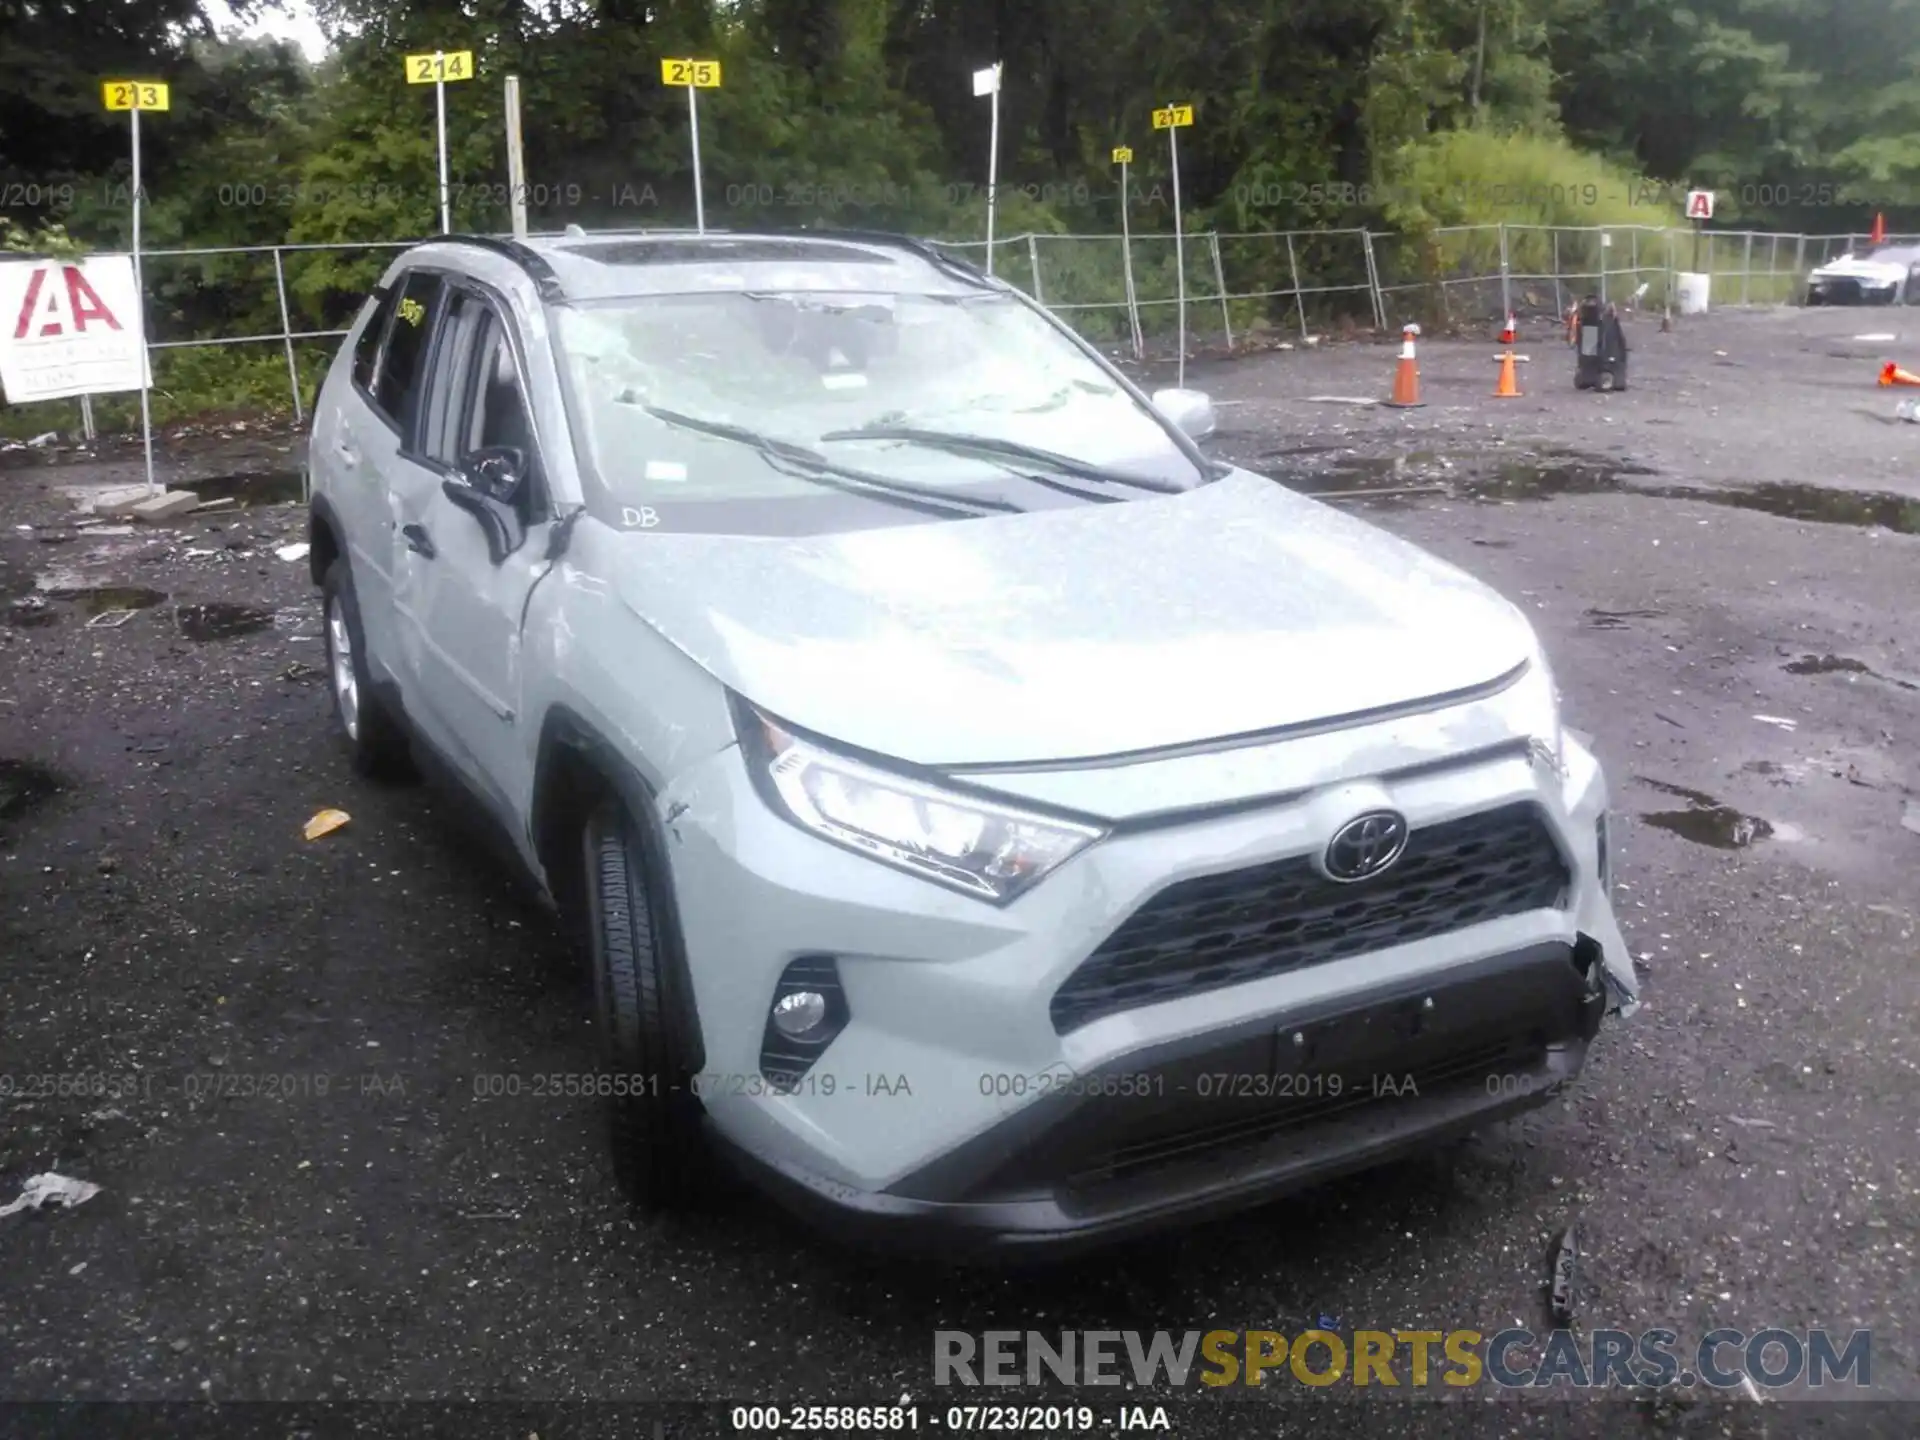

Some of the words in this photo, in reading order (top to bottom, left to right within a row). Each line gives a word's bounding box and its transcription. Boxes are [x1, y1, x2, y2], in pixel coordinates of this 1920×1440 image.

[417, 56, 463, 79] 214
[672, 63, 711, 84] 215
[114, 86, 157, 106] 213
[1159, 109, 1186, 126] 217
[1690, 195, 1709, 216] A
[621, 504, 661, 527] DB
